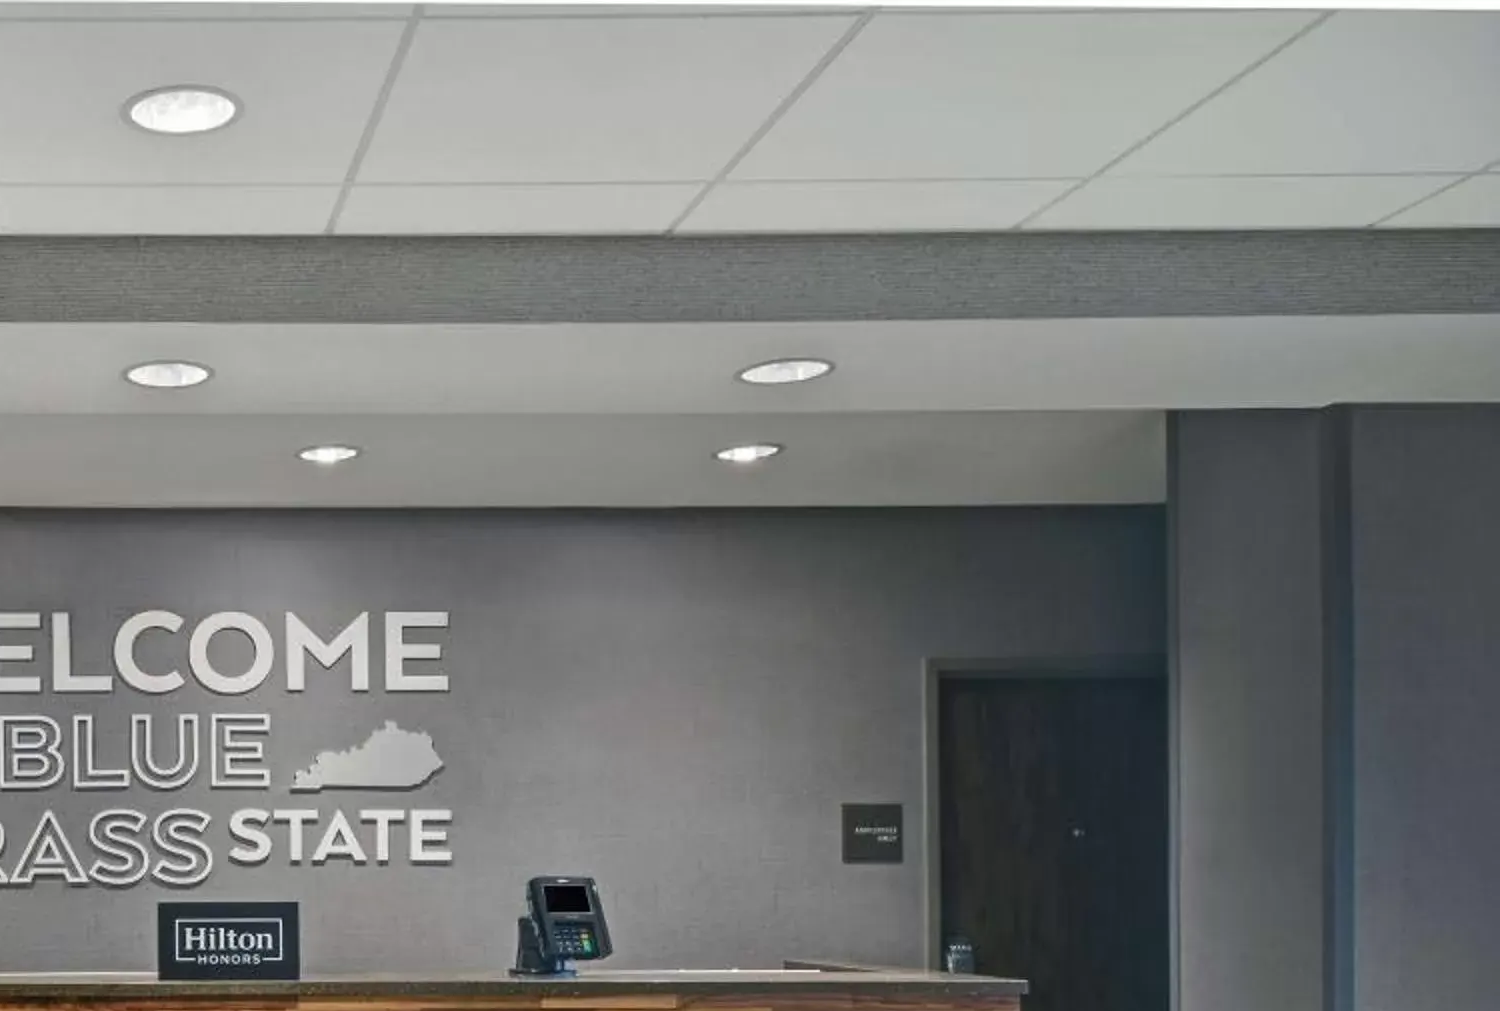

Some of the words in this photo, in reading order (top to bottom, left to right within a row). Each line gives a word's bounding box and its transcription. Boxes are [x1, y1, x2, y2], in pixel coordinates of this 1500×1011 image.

[227, 807, 453, 864] STATE
[183, 926, 274, 951] Hilton
[197, 953, 262, 965] HONORS
